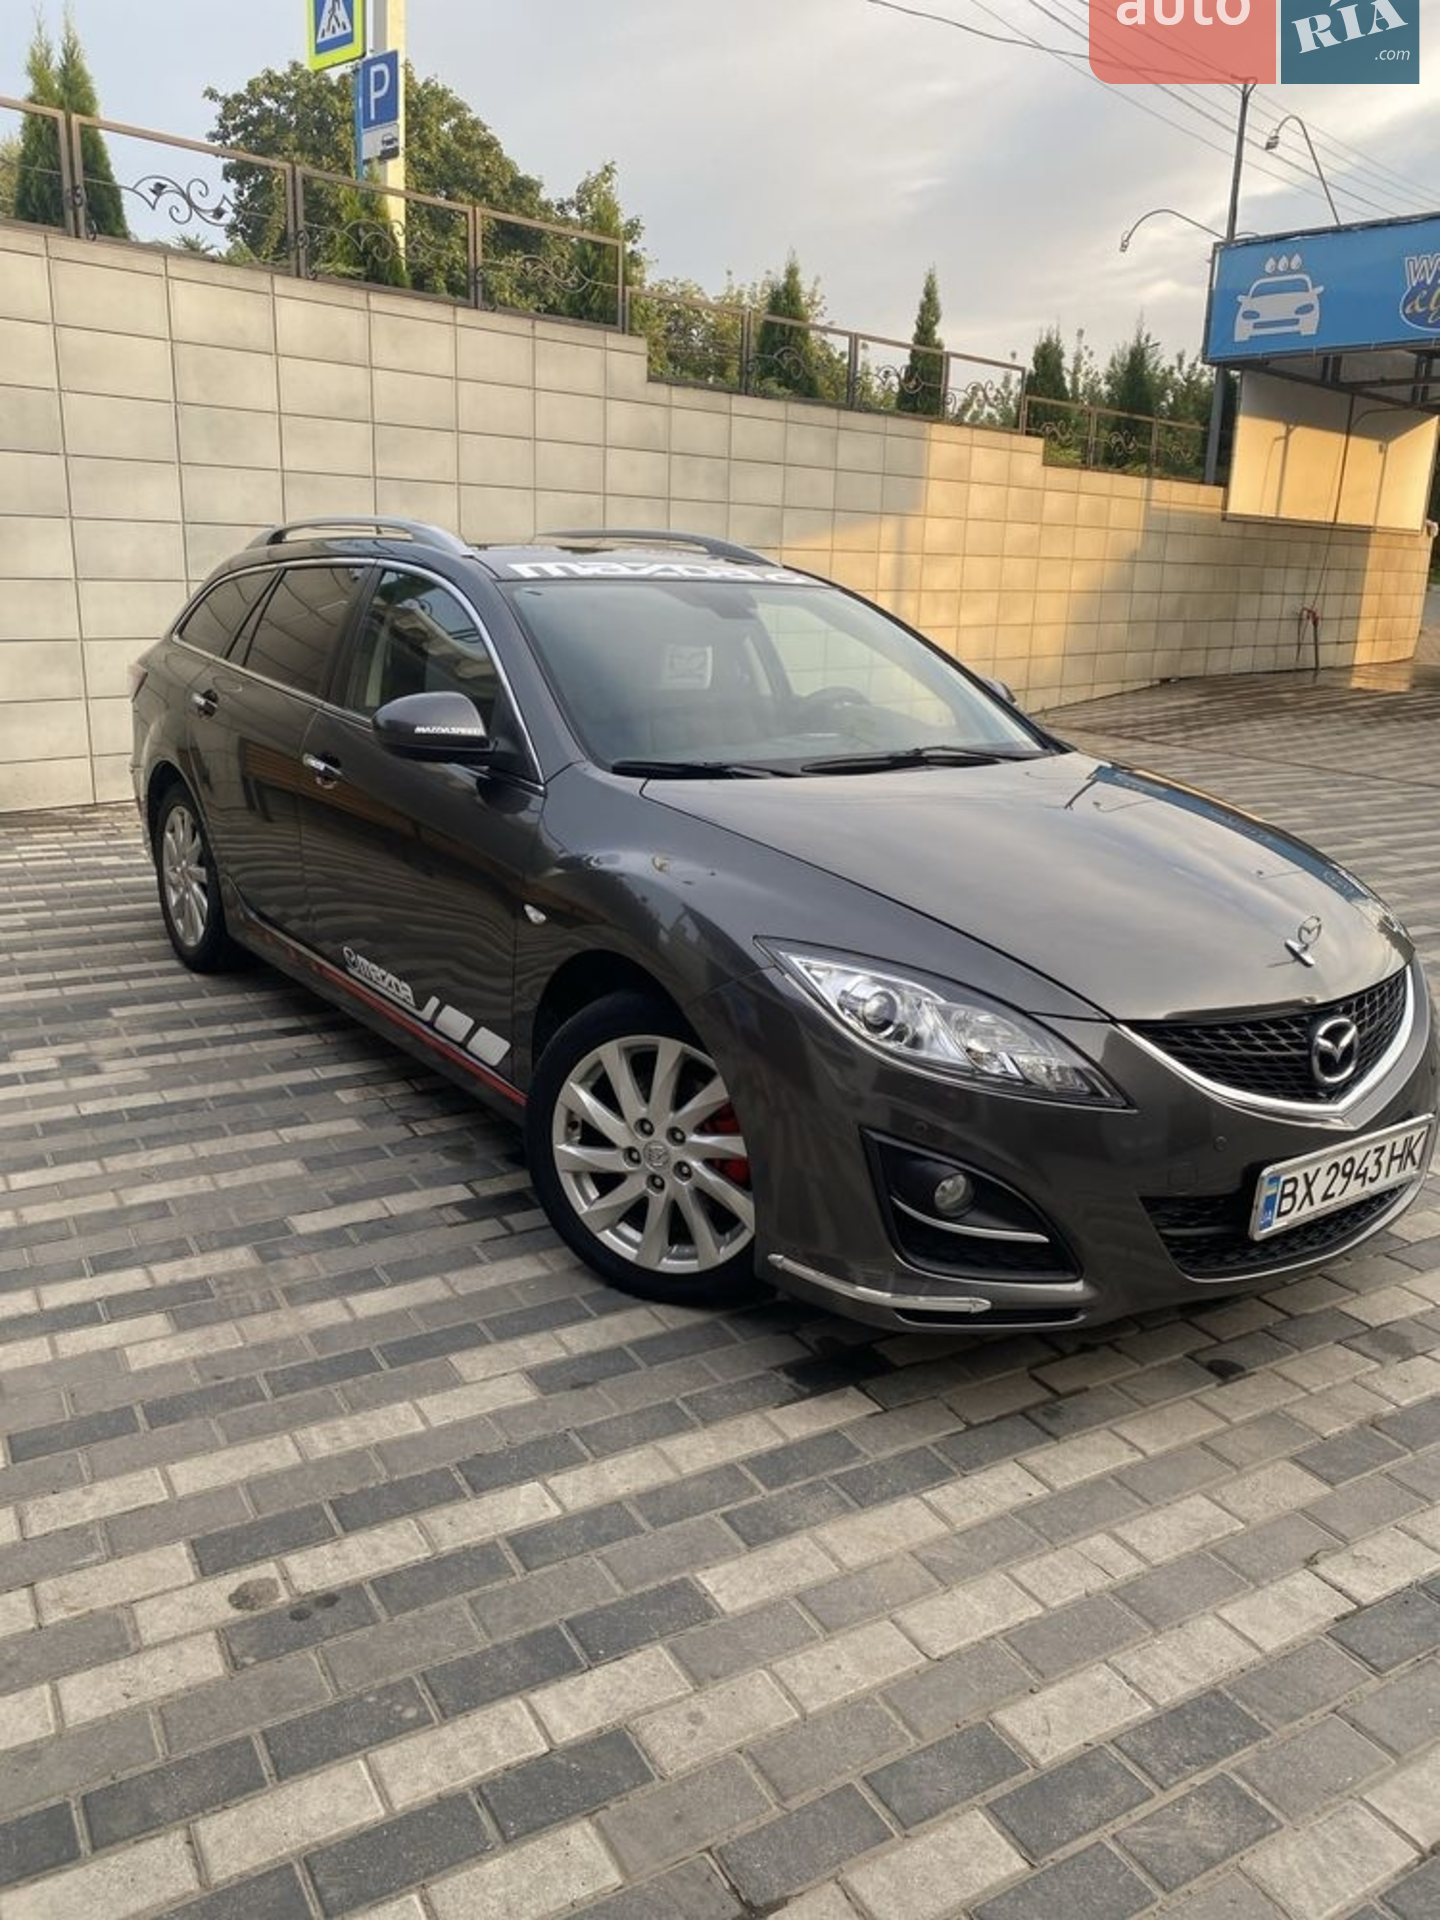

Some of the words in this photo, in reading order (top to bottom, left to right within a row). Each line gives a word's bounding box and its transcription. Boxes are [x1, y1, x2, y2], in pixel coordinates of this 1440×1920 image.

[370, 62, 390, 121] P
[1276, 1167, 1321, 1219] BX
[1321, 1145, 1386, 1202] 2943
[1385, 1130, 1425, 1178] HK
